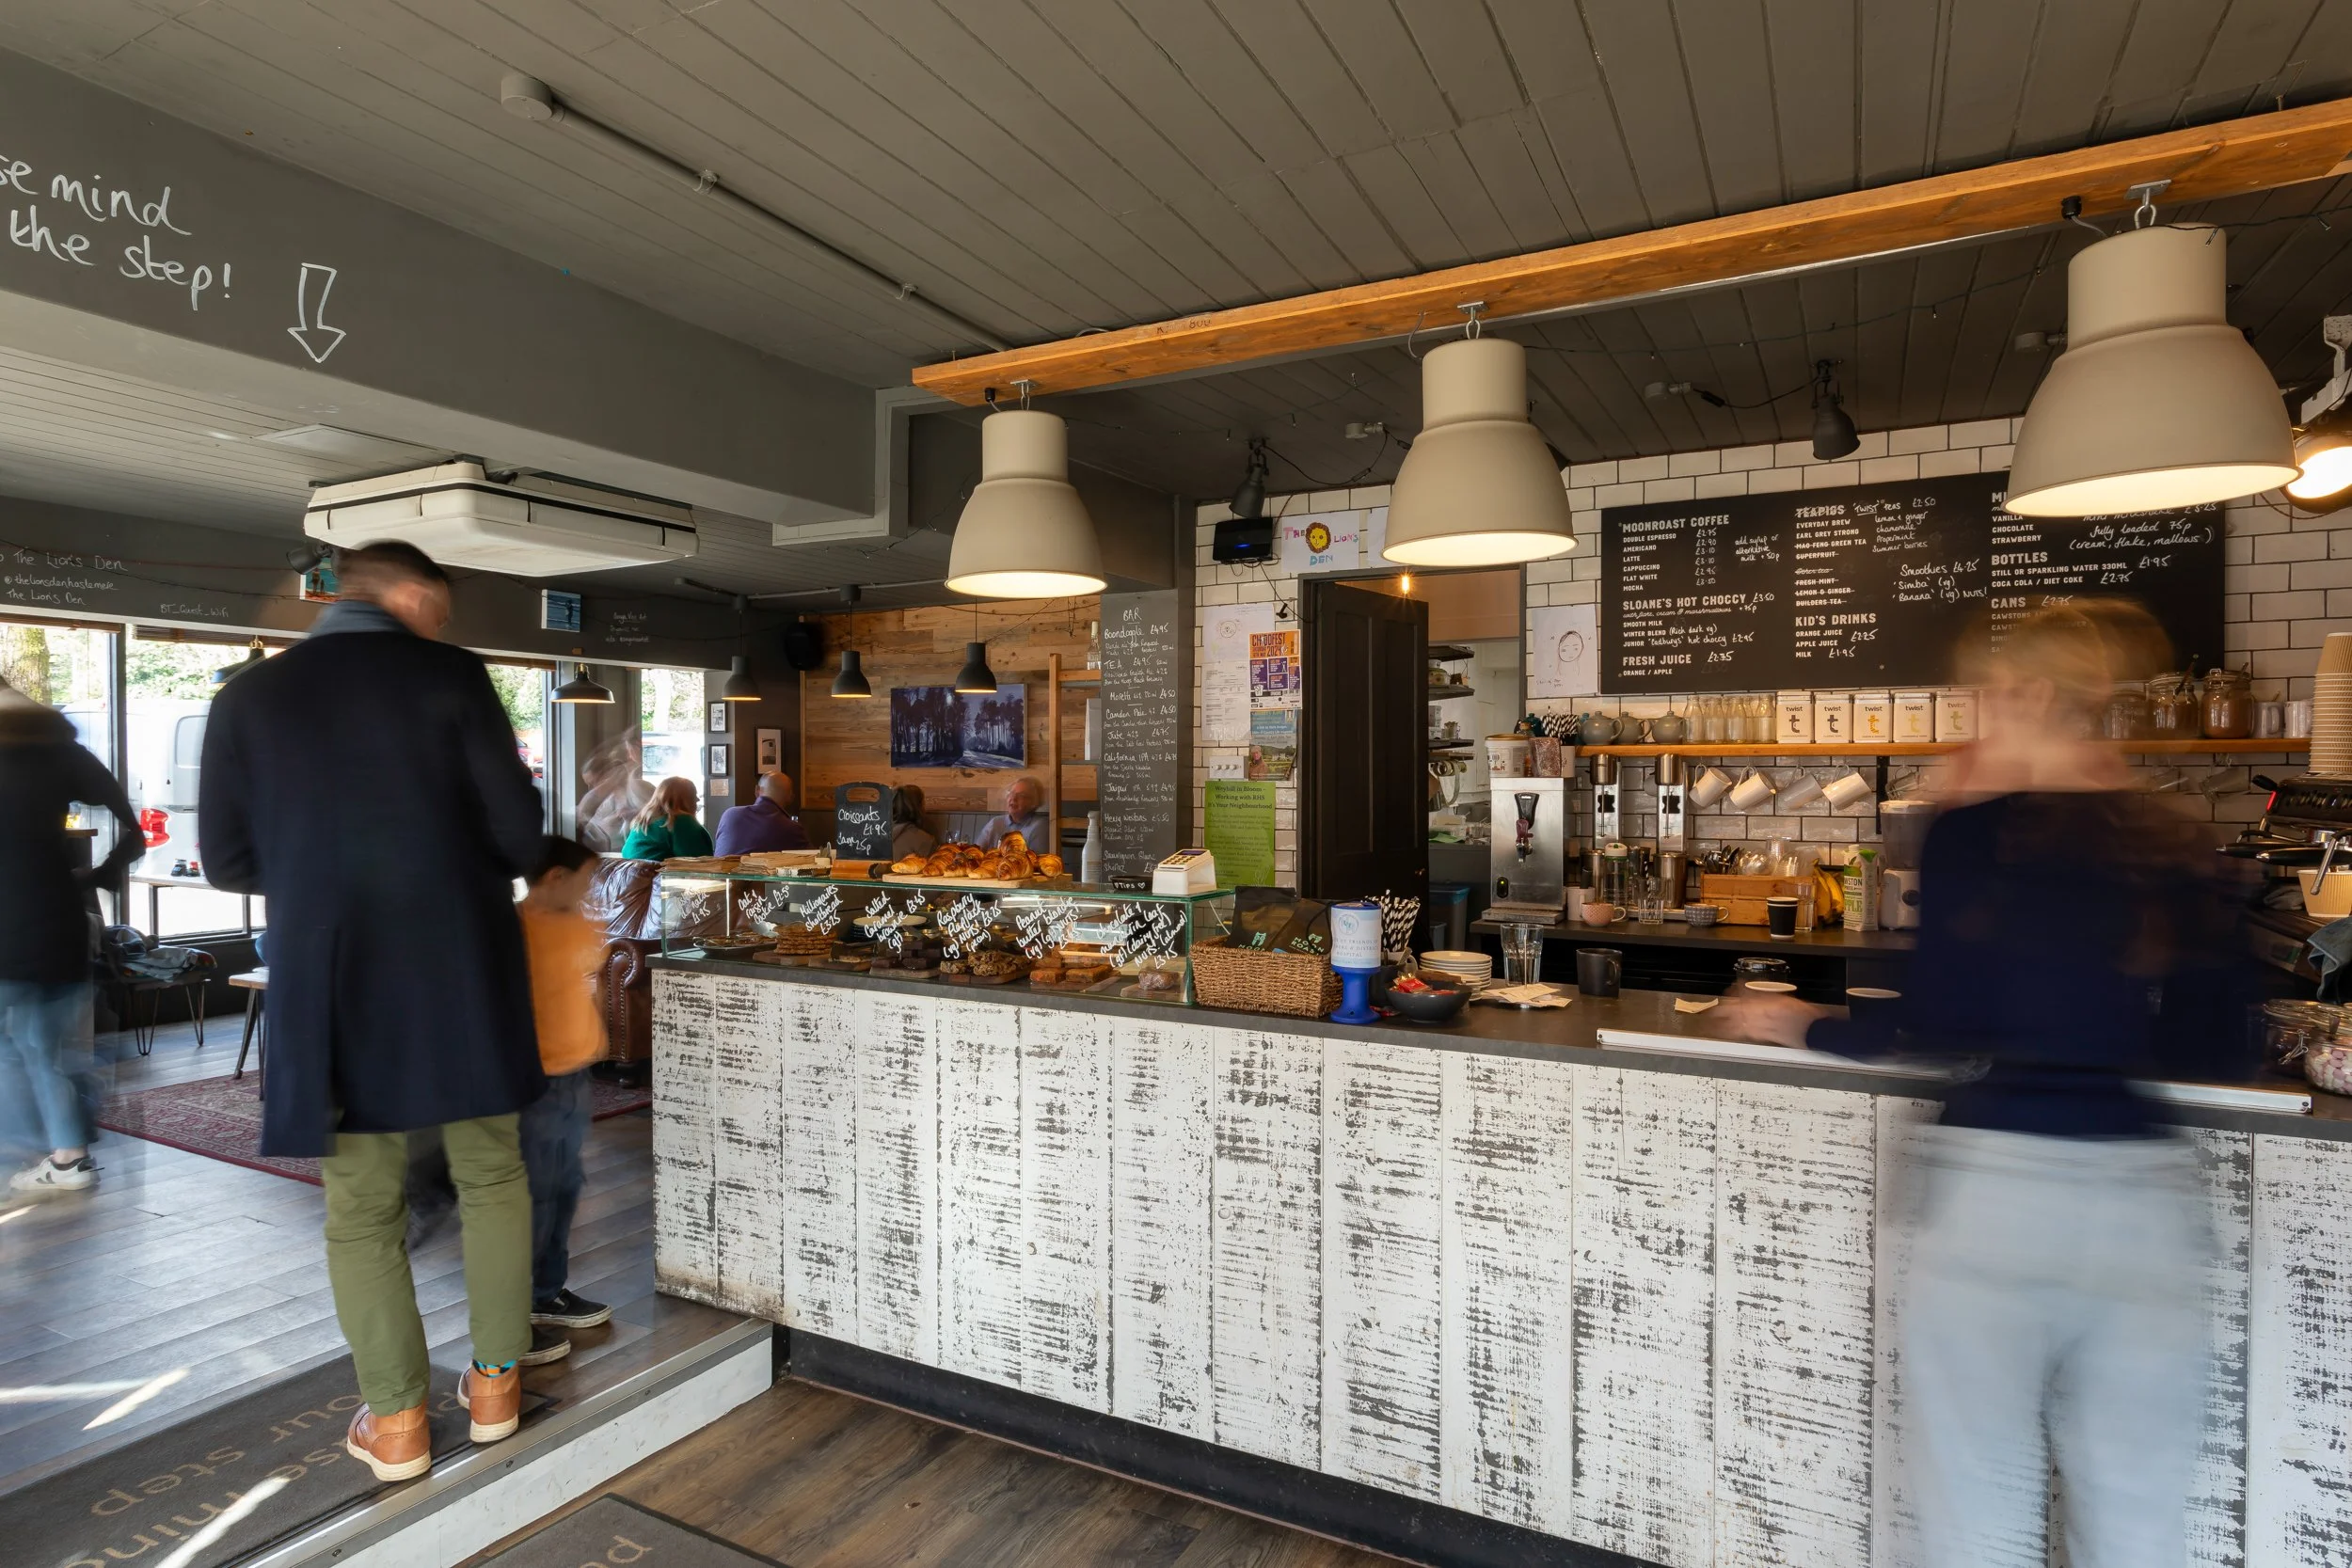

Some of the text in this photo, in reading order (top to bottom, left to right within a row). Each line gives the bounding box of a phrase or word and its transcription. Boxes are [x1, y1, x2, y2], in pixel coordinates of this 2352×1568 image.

[52, 174, 192, 235] mind
[10, 205, 230, 311] the step!
[1883, 502, 1901, 511] teas
[1623, 515, 1729, 533] MOONROAST COFFEE
[1905, 511, 1928, 525] ginger
[1282, 526, 1306, 541] THE
[1992, 524, 2034, 533] CHOCOLATE
[2090, 518, 2192, 541] fully loaded 75p
[1735, 536, 1747, 546] add
[1750, 536, 1767, 547] syrup
[1992, 534, 2042, 544] STRAWBERRY
[1735, 546, 1770, 555] alternative
[1872, 545, 1901, 553] Summer
[95, 555, 128, 572] Den
[1309, 555, 1334, 566] DEN
[1740, 552, 1780, 562] milk 50p
[1991, 551, 2048, 565] BOTTLES
[1900, 562, 1947, 577] Smoothies
[8, 590, 26, 602] The
[66, 594, 86, 606] Den
[1623, 593, 1774, 610] SLOANE'S HOT CHOCCY £3.50
[1940, 586, 1988, 603] (vg) NUTS!
[1991, 596, 2026, 610] CANS
[1123, 607, 1142, 622] BAR
[1795, 613, 1877, 626] KID'S DRINKS
[1104, 626, 1144, 644] Boondoggle
[1688, 636, 1700, 644] hot
[1703, 635, 1726, 647] choccy
[1104, 660, 1122, 670] TEA
[1623, 654, 1692, 666] FRESH JUICE
[837, 805, 881, 824] Croissants
[799, 884, 839, 918] Millionaires
[865, 891, 891, 919] Salted
[805, 894, 844, 932] shortbread
[1015, 900, 1047, 930] Peanut
[1015, 920, 1041, 948] butter
[90, 1445, 246, 1517] step
